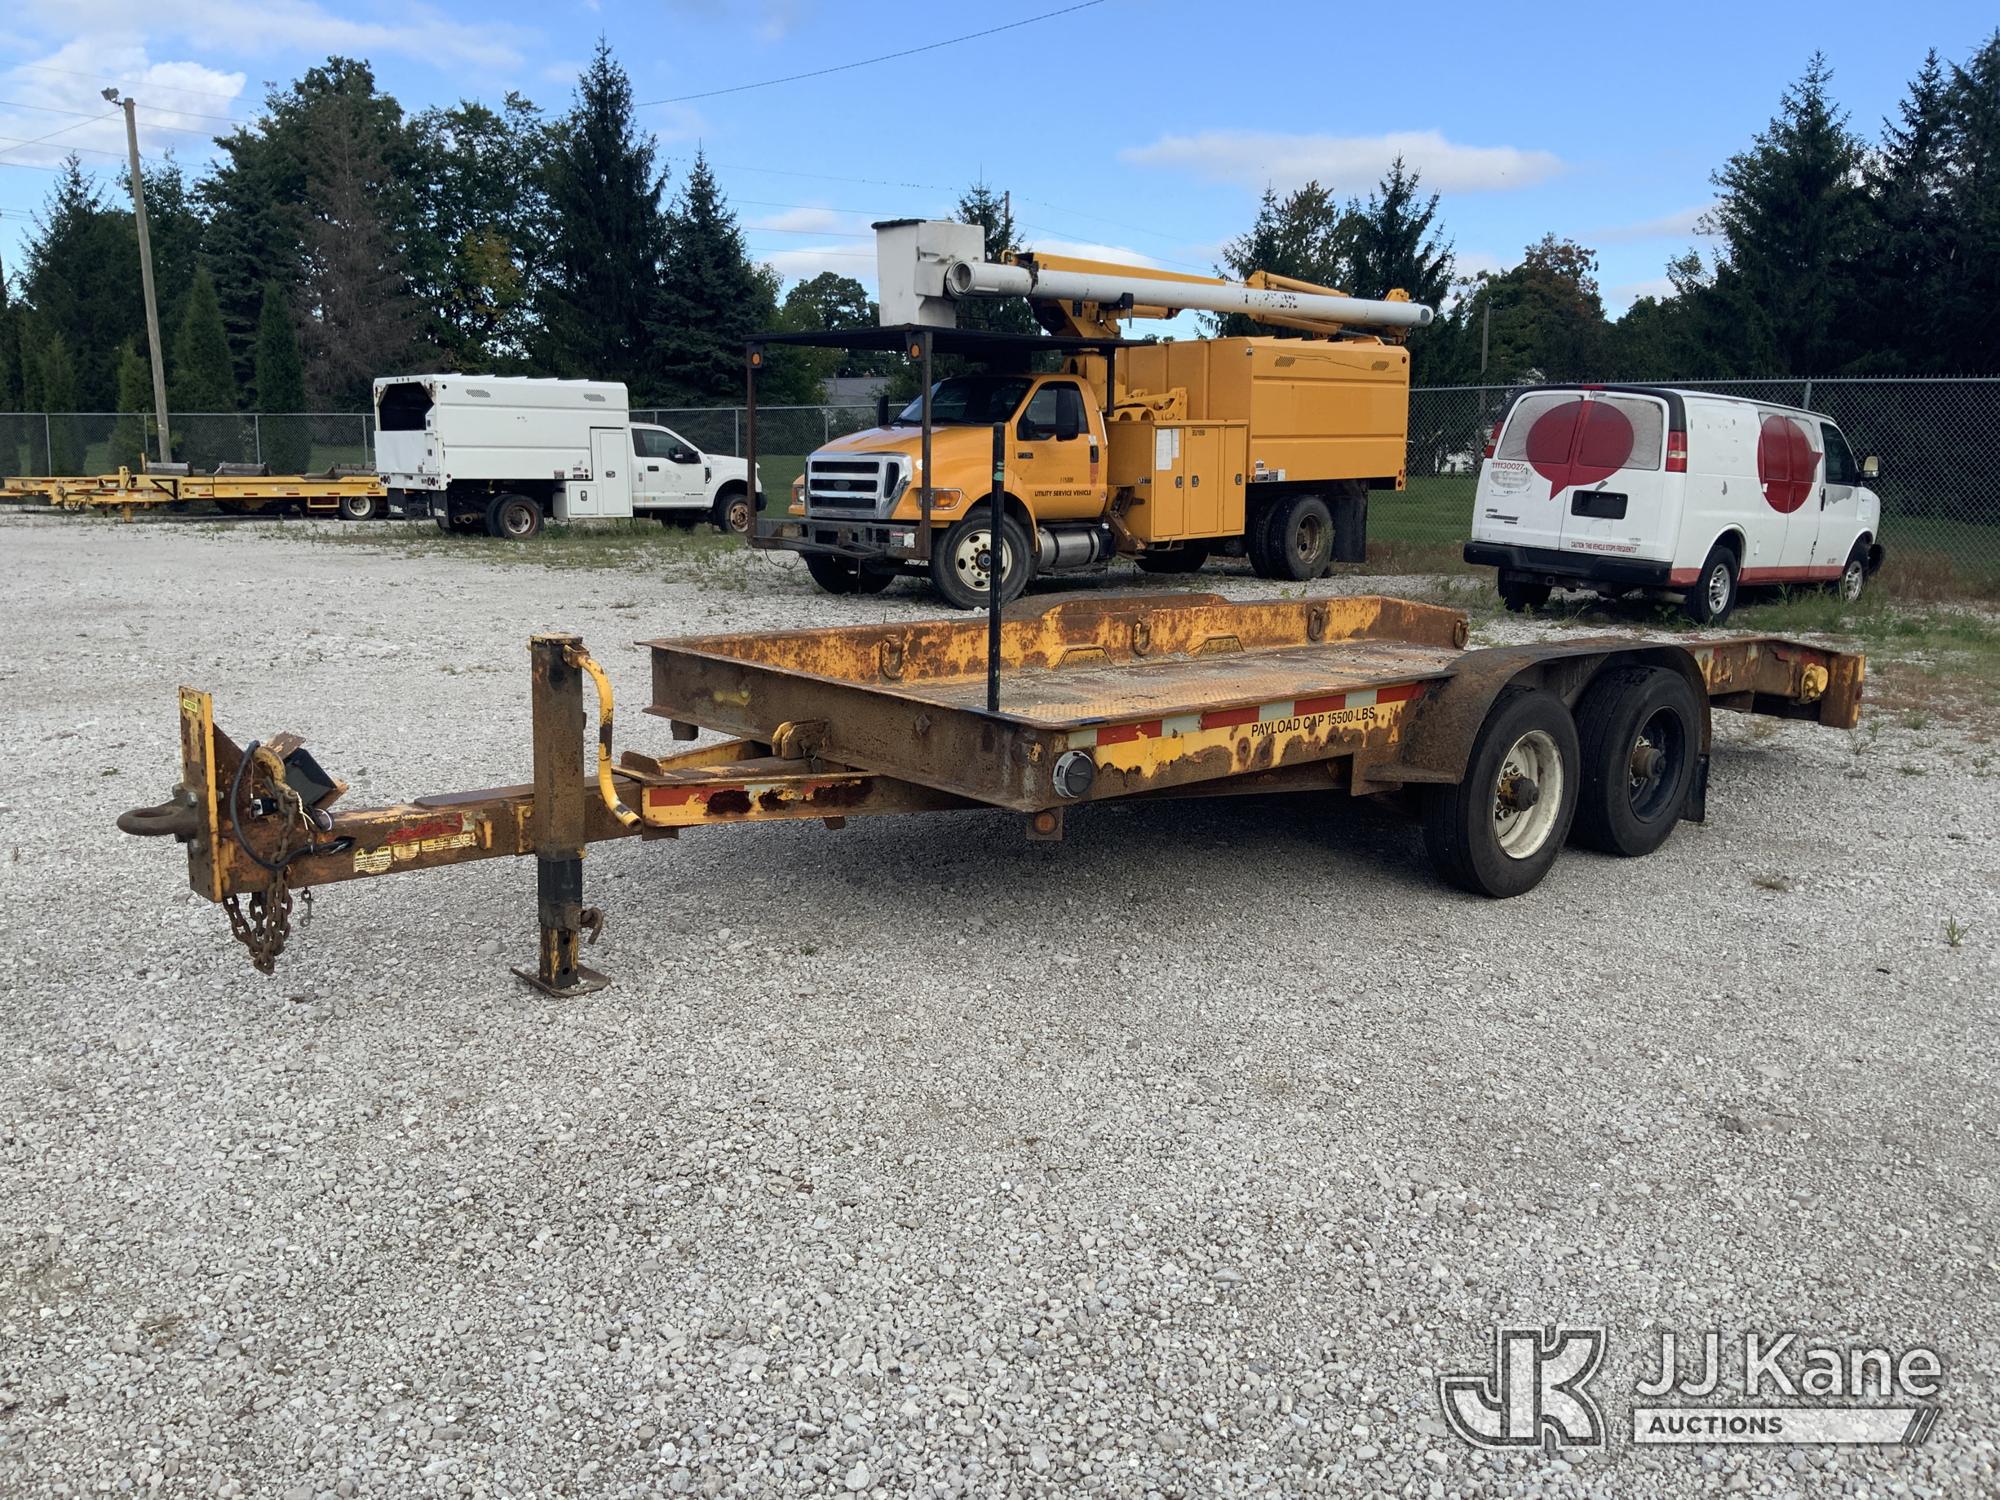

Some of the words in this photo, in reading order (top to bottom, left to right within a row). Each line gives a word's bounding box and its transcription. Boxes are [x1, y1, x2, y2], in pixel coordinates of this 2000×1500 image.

[1251, 718, 1300, 737] PAYLOAD
[1303, 714, 1325, 730] CAP
[1327, 710, 1354, 725] 15500
[1356, 706, 1375, 721] LBS
